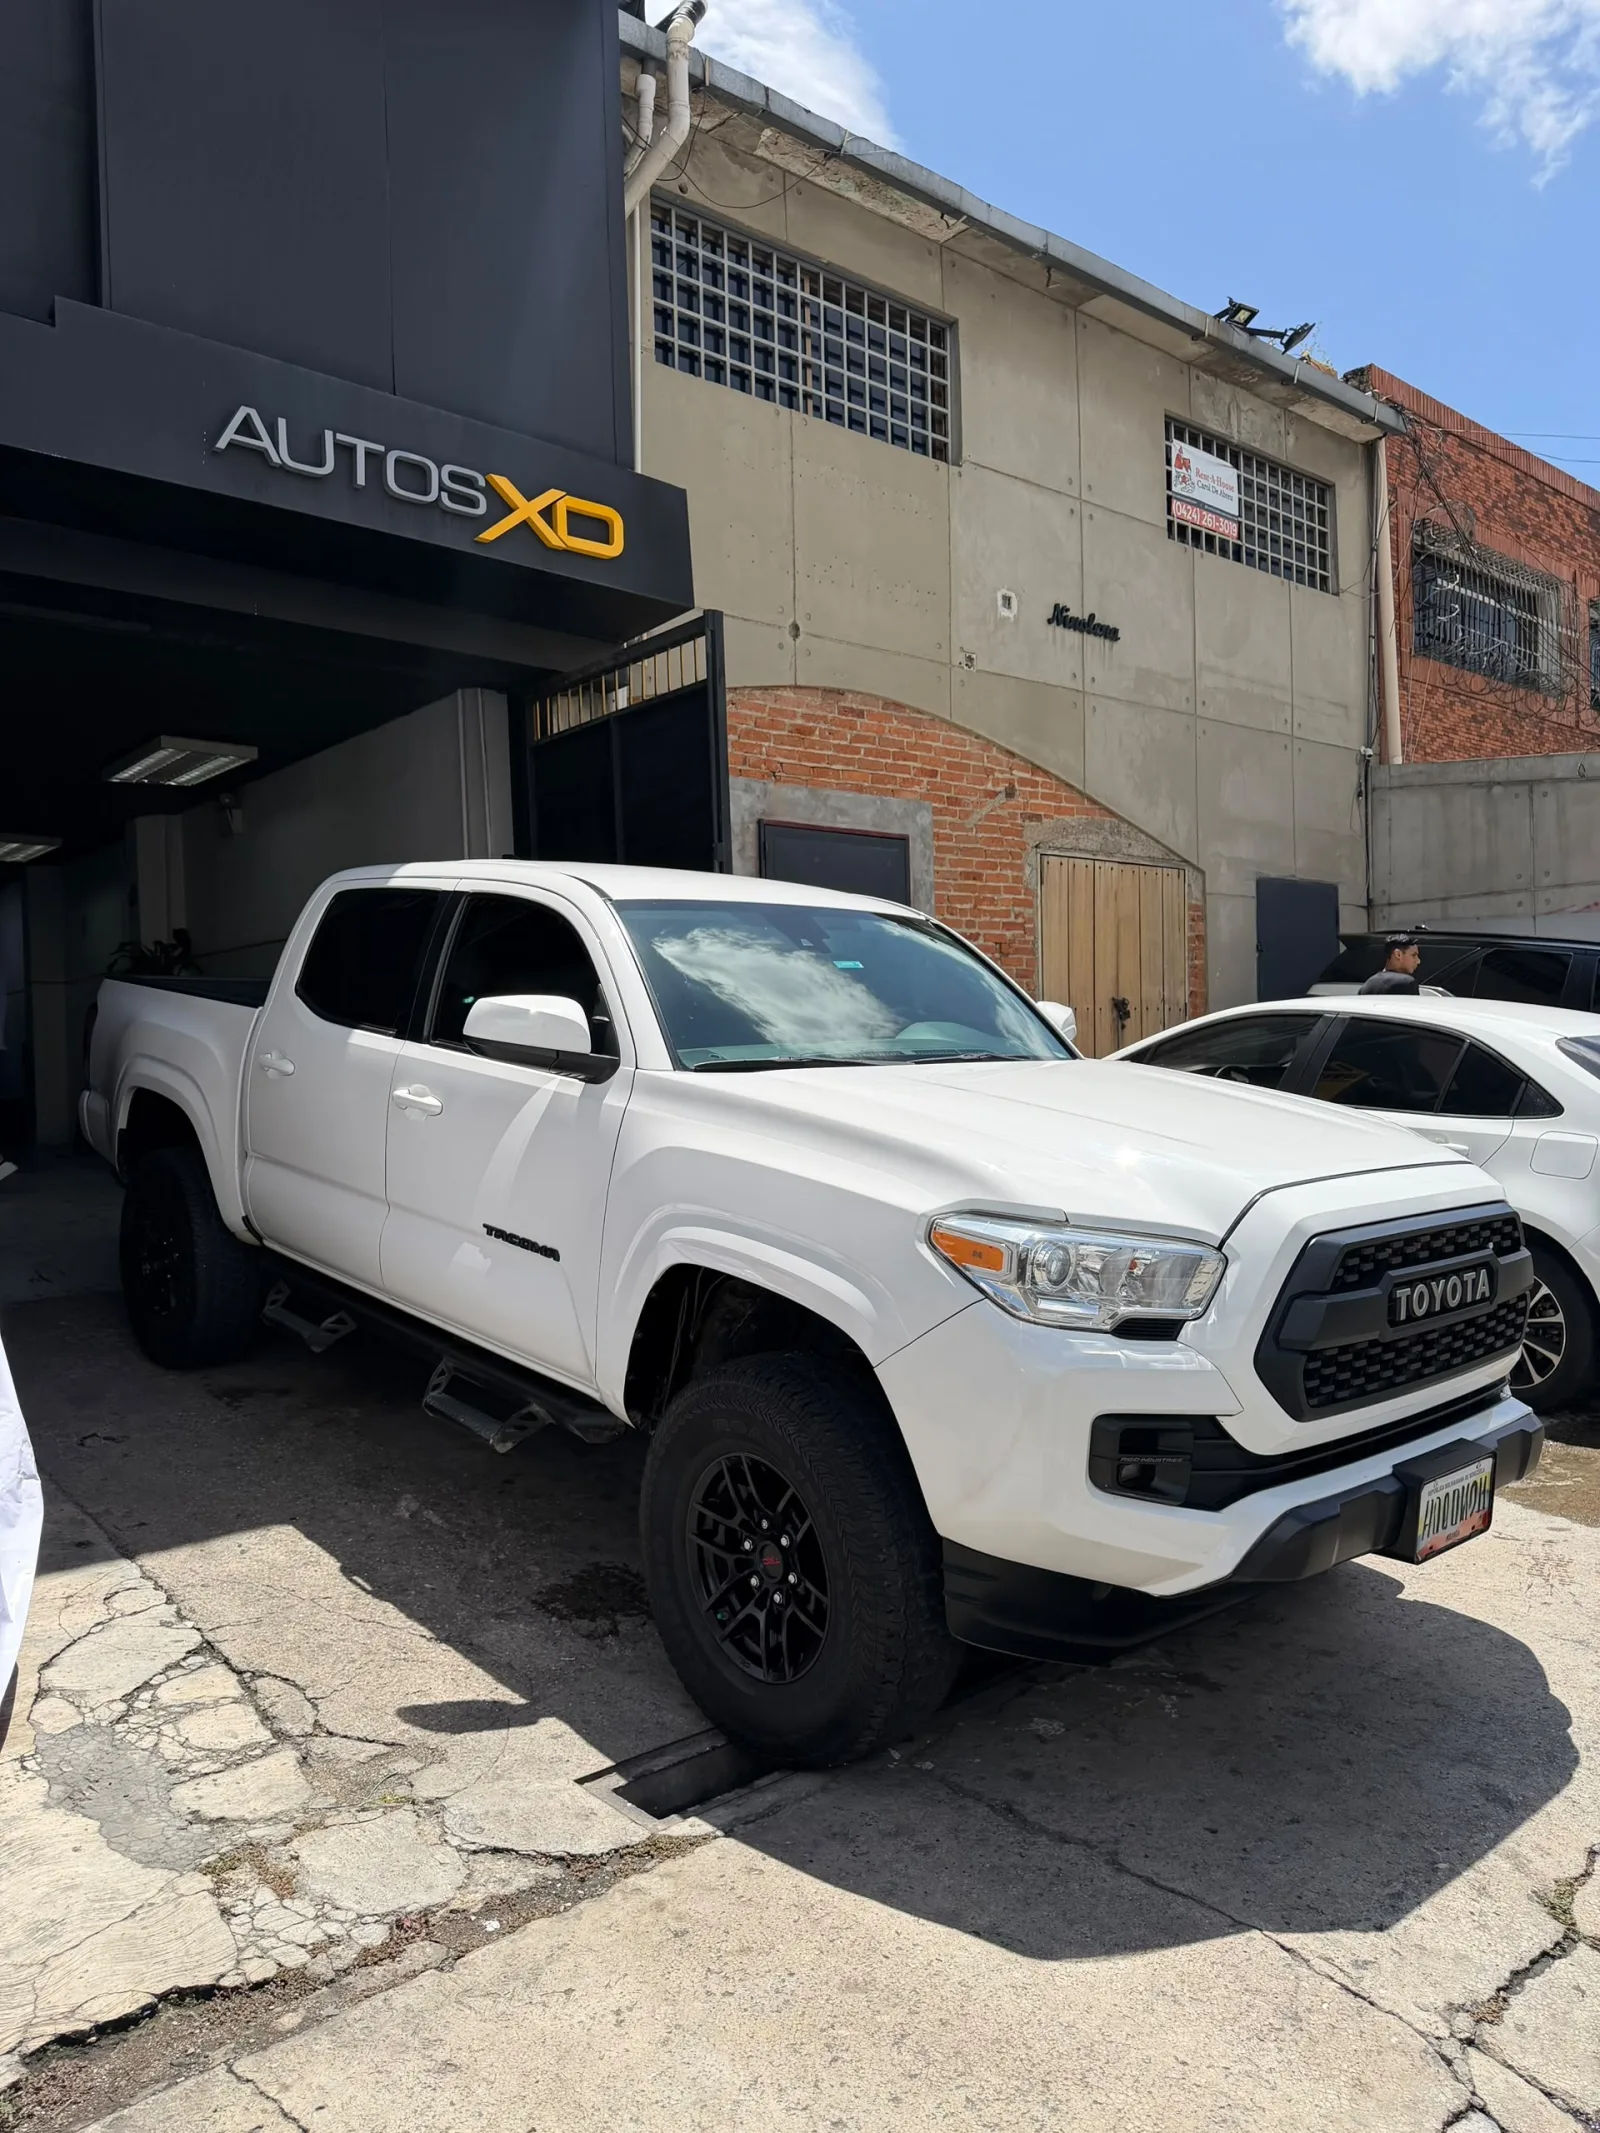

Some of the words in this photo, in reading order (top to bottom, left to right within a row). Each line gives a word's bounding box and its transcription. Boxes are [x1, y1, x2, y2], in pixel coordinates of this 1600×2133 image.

[1172, 500, 1201, 525] (0424)
[1202, 510, 1238, 537] 261-3019
[1396, 1269, 1490, 1321] TOYOTA
